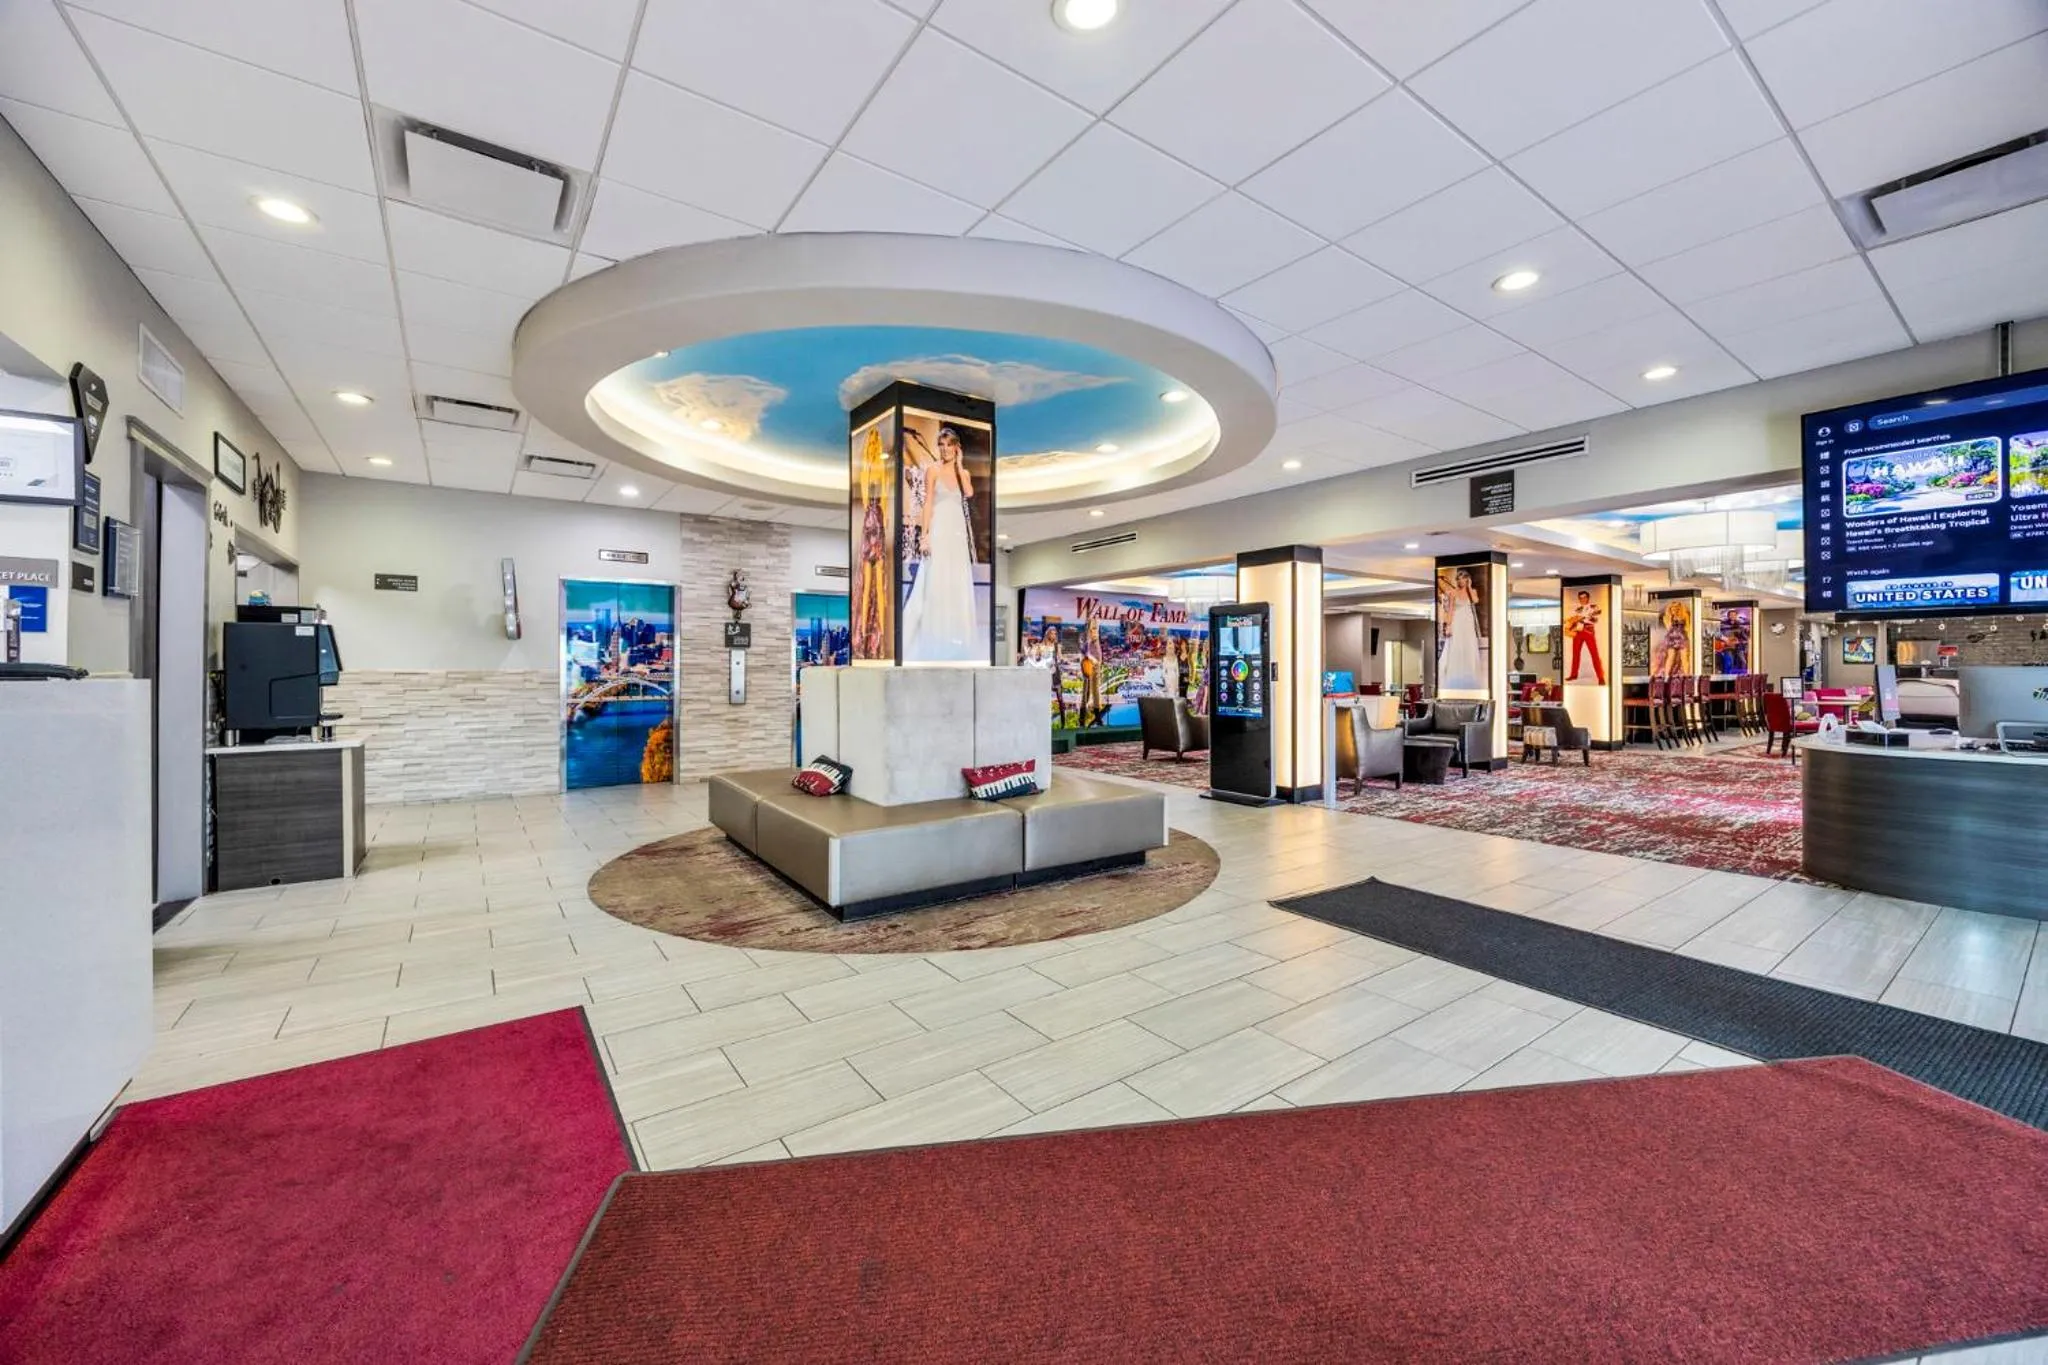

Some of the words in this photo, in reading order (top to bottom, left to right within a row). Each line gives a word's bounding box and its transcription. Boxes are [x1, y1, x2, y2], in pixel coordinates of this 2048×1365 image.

[1877, 414, 1909, 426] Search
[1844, 447, 1864, 455] From
[1865, 439, 1915, 452] recommended
[1917, 433, 1951, 444] searches
[1845, 519, 1885, 529] Wonders
[1887, 517, 1898, 525] of
[1900, 513, 1932, 523] Hawaii
[1940, 508, 1987, 521] Exploring
[2010, 514, 2039, 522] Ultra
[1884, 521, 1946, 535] Breathtaking
[1949, 517, 1990, 530] Tropical
[1846, 569, 1869, 577] Watch
[1870, 568, 1890, 576] again
[1856, 591, 1917, 603] UNITED
[1922, 588, 1989, 600] STATES
